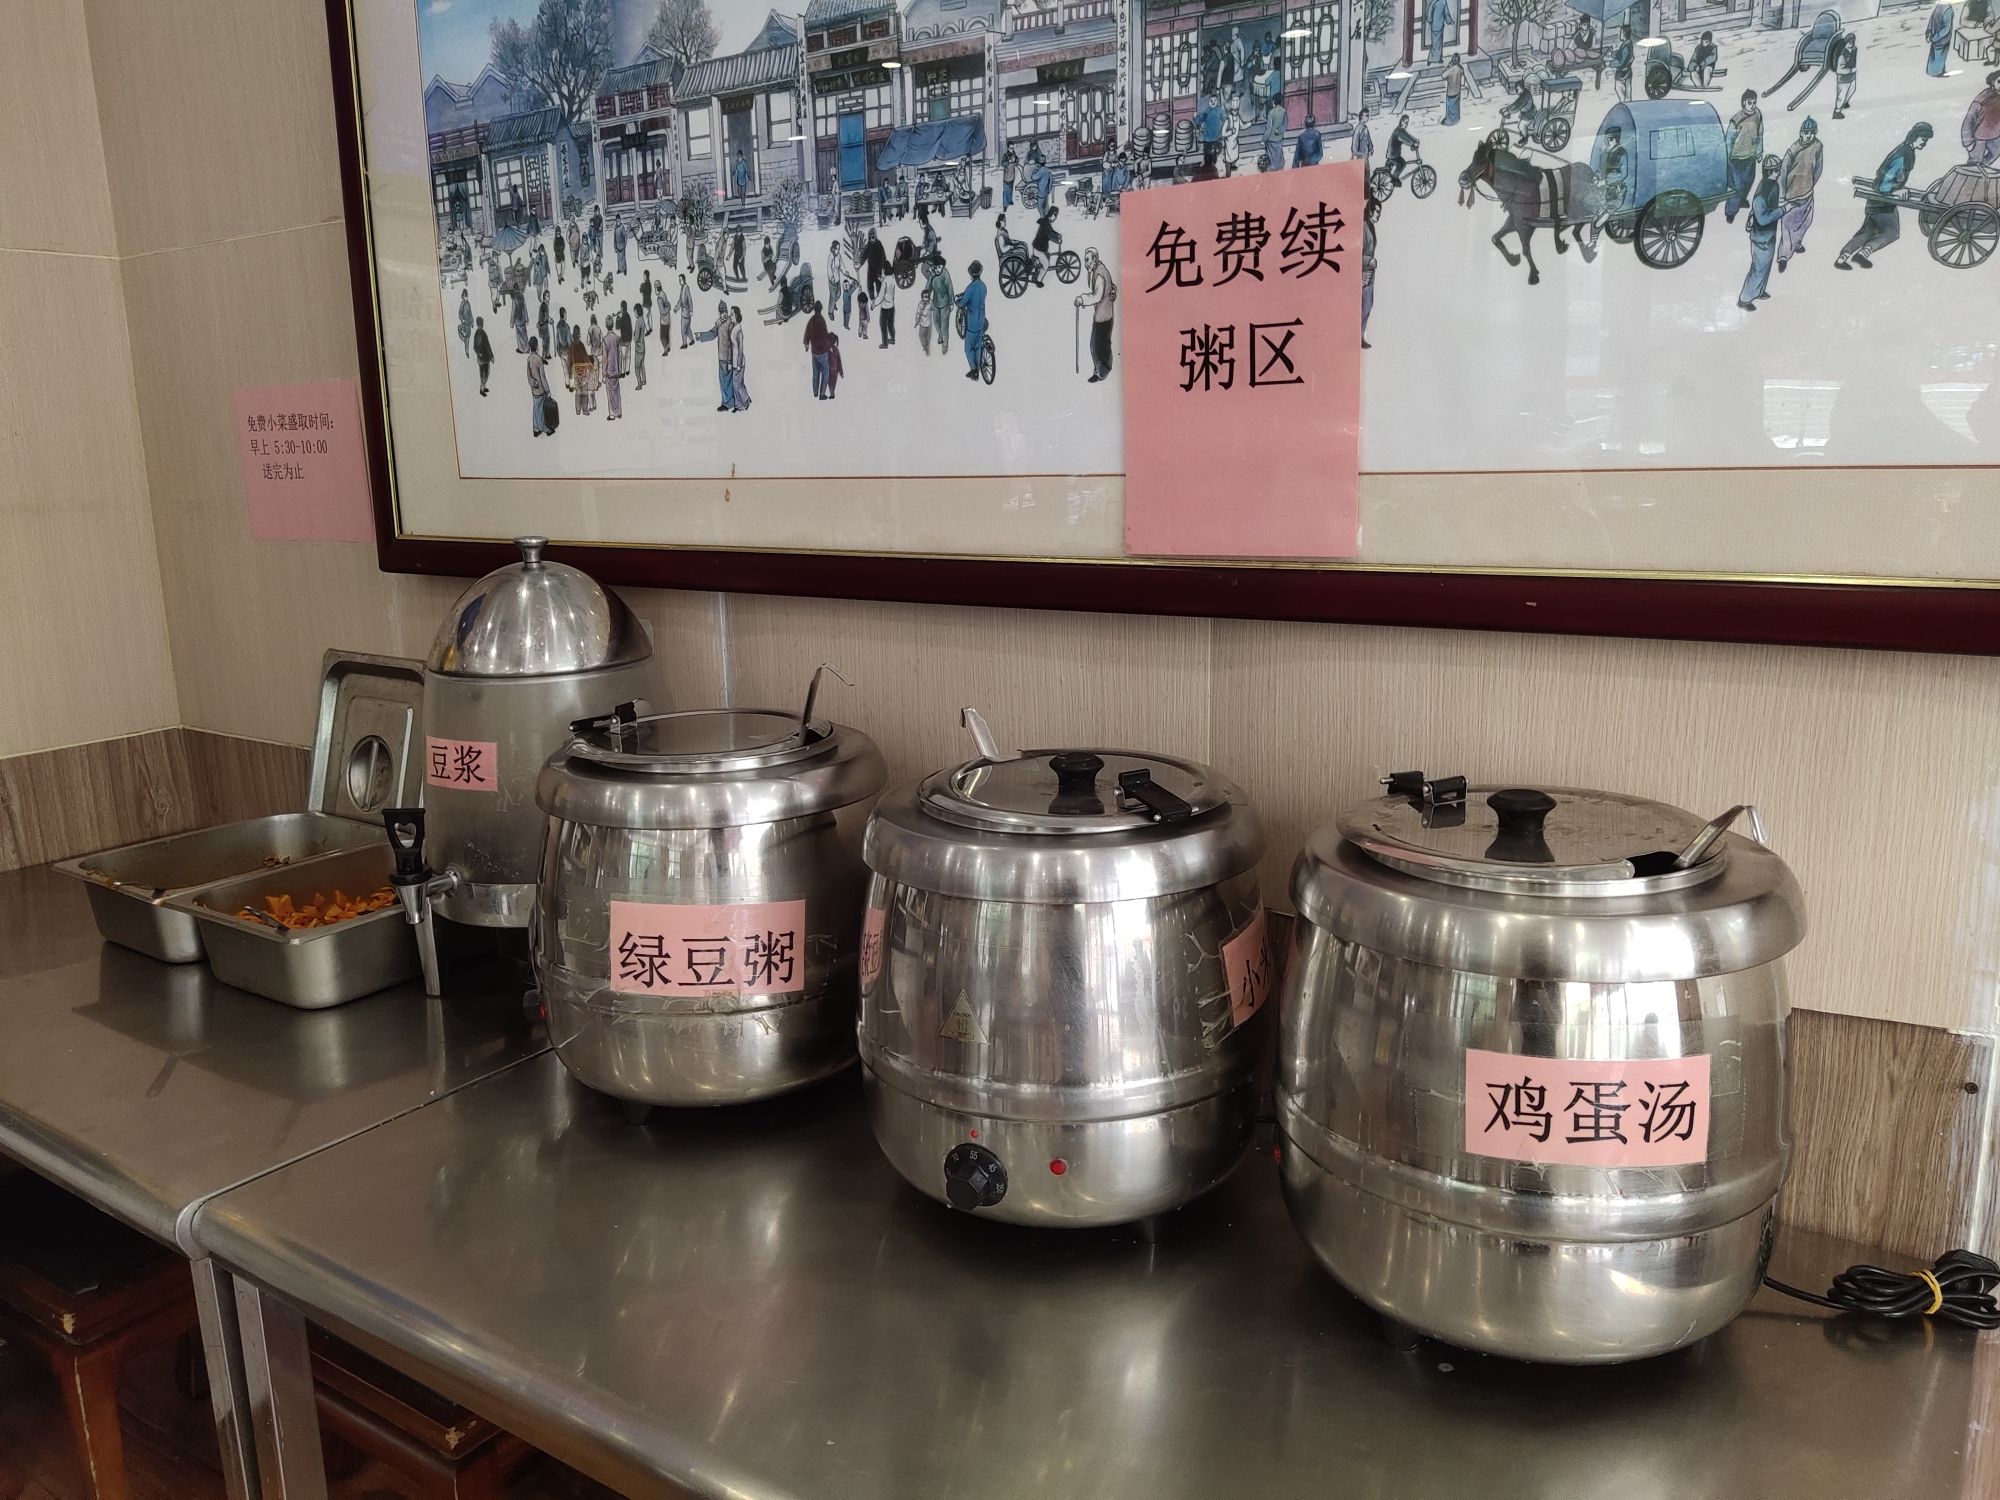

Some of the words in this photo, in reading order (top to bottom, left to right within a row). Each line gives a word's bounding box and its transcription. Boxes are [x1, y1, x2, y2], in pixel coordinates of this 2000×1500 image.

[1145, 201, 1345, 294] 免费续
[1179, 317, 1304, 392] 粥区
[247, 412, 334, 432] 免费小菜盛取时间：
[250, 439, 271, 456] 早上
[274, 439, 328, 455] 5:30-10:00
[262, 461, 304, 480] 送完为止
[431, 745, 486, 783] 豆浆
[618, 930, 795, 988] 绿豆粥
[1484, 1076, 1696, 1145] 鸡蛋汤
